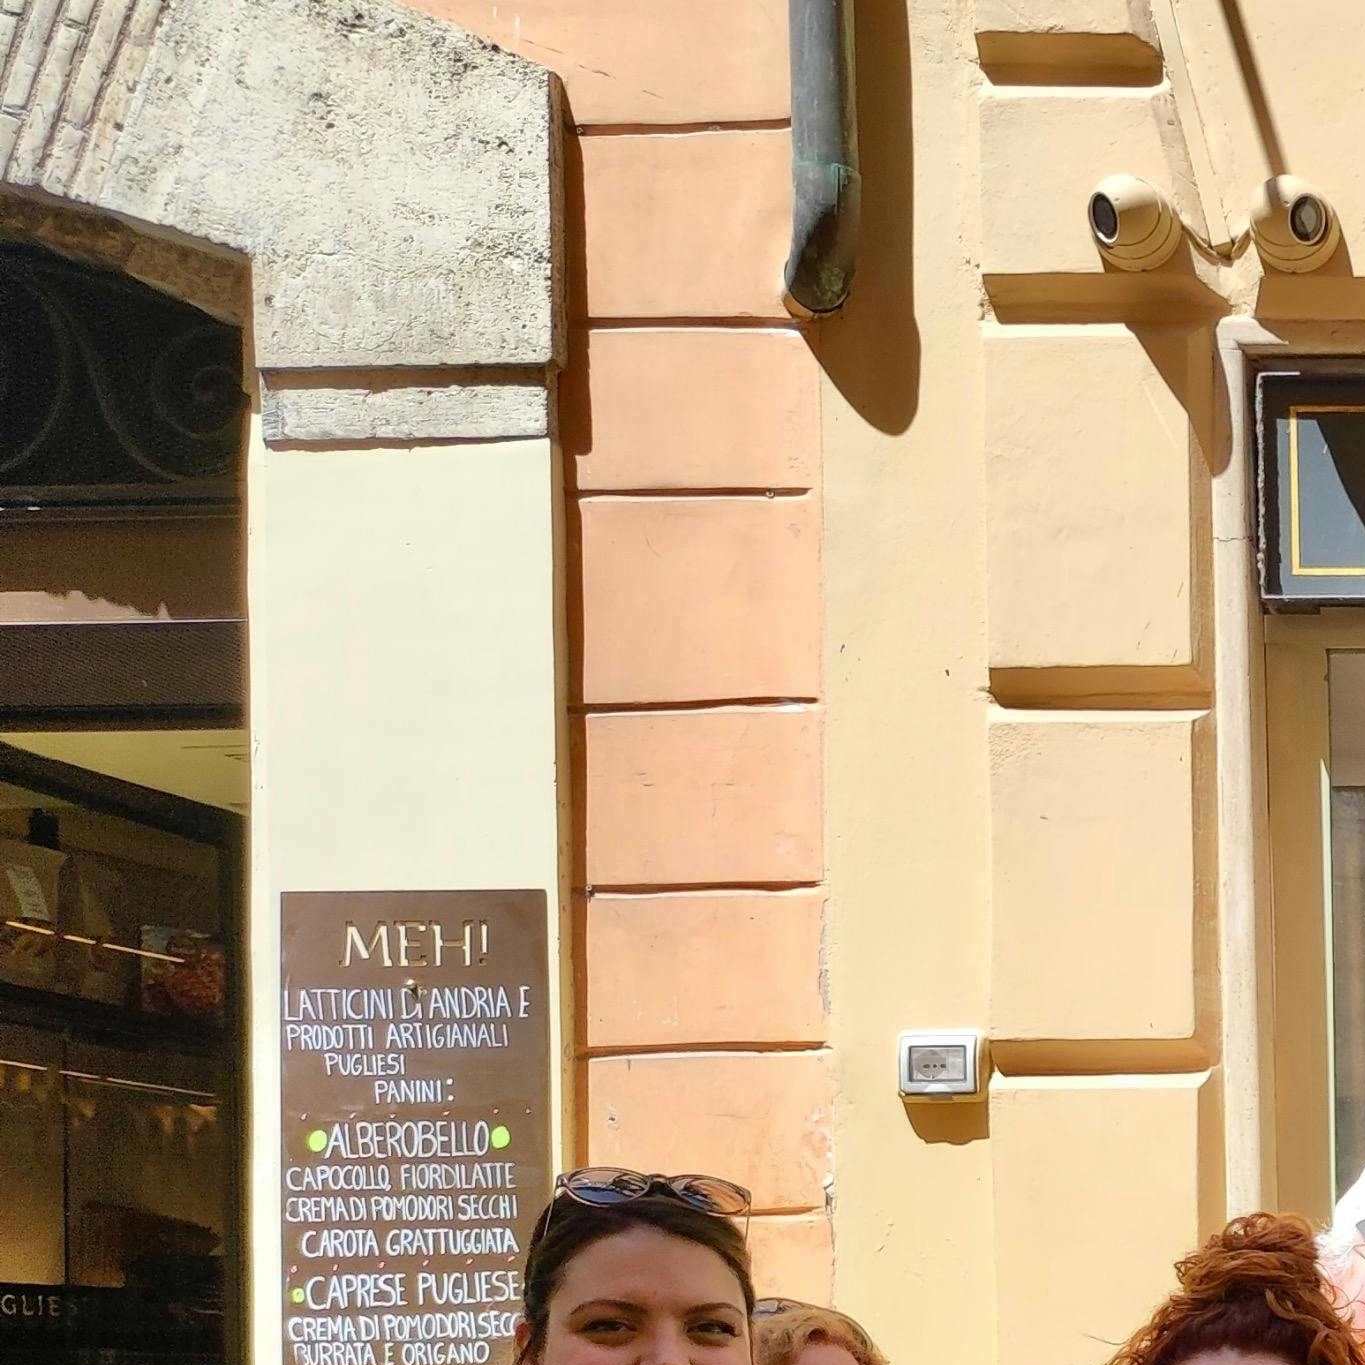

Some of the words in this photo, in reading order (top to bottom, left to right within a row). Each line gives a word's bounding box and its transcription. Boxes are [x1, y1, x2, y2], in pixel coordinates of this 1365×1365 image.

[283, 987, 393, 1021] LATTICINI
[428, 986, 512, 1019] ANDRIA
[518, 985, 531, 1019] E
[286, 1023, 373, 1051] PRODOTTI
[385, 1022, 509, 1049] ARTIGIANALI
[324, 1052, 406, 1077] PUGLIESI
[324, 1120, 491, 1160] ALBEROBELLO
[401, 1162, 517, 1190] FIORDILATTE
[285, 1197, 353, 1223] CREMA
[351, 1195, 368, 1221] DI
[372, 1195, 454, 1222] POMODORI
[458, 1194, 518, 1221] SECCHI
[301, 1229, 380, 1258] CAROTA
[386, 1227, 520, 1257] GRATTUGGIATA
[306, 1272, 408, 1311] CAPRESE
[418, 1270, 522, 1306] PUGLIESE
[288, 1315, 356, 1342] CREMA
[361, 1315, 380, 1342] DI
[385, 1312, 476, 1341] POMODORI
